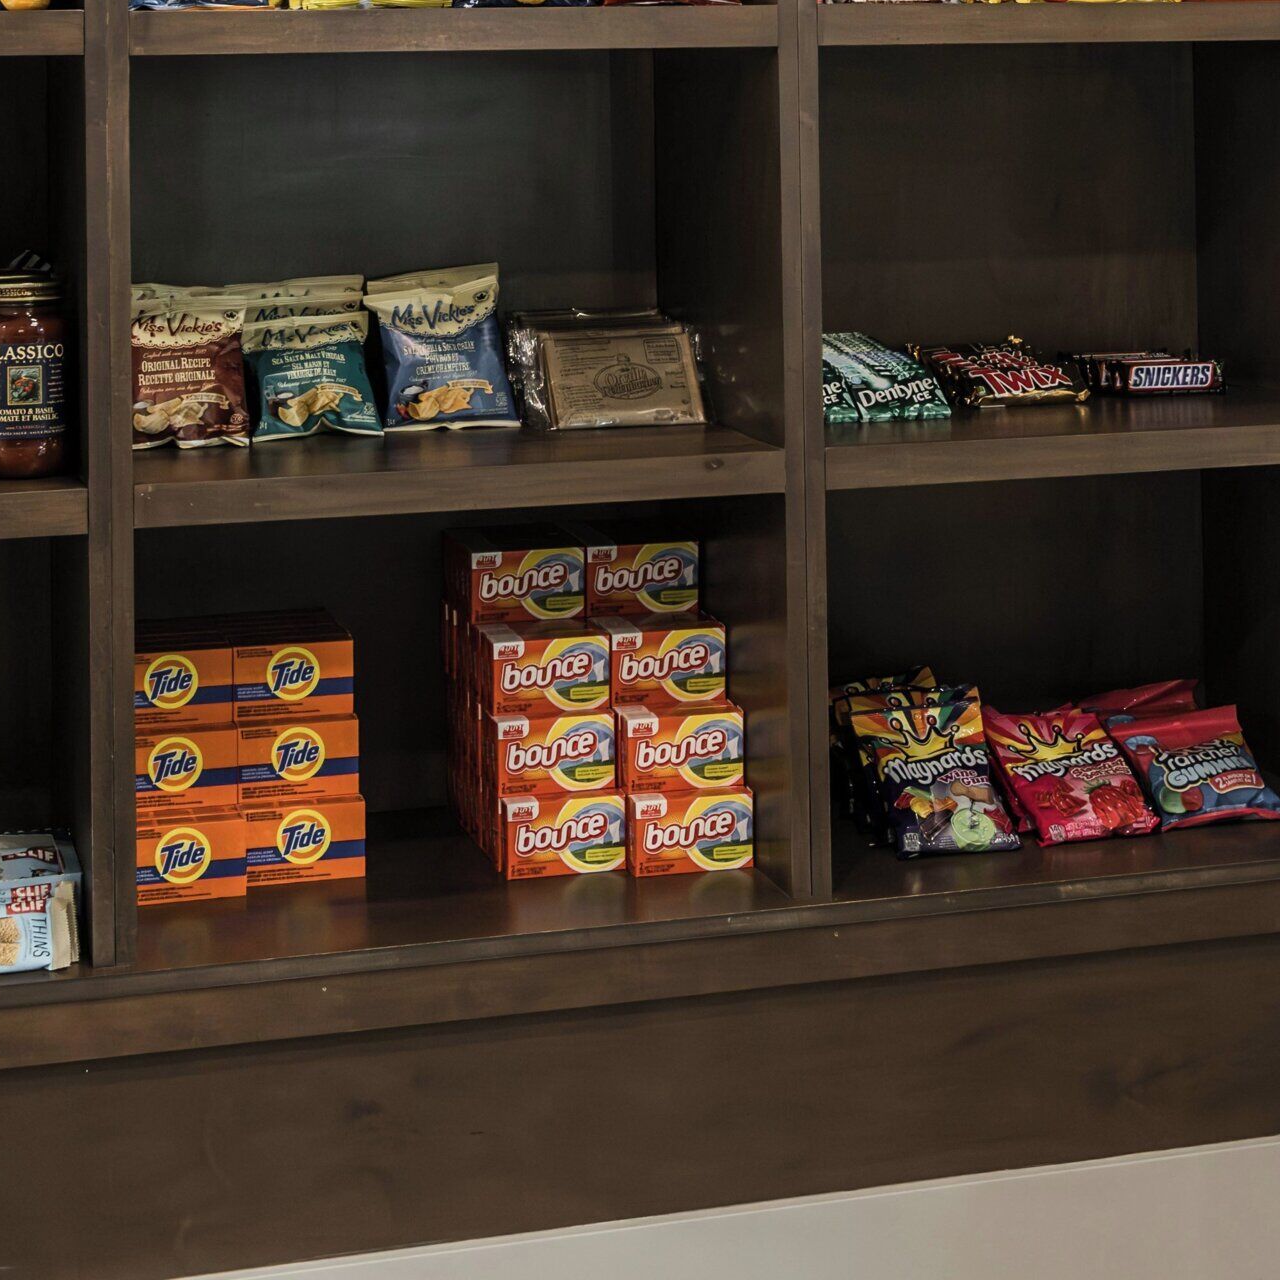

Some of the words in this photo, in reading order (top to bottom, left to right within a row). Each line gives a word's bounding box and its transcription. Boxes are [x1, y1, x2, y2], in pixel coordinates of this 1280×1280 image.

[167, 314, 222, 336] Vickie's
[392, 304, 423, 329] Miss
[422, 300, 475, 329] Vickie's
[138, 373, 173, 386] RECETTE
[175, 370, 215, 382] ORIGINALE
[141, 360, 180, 372] ORIGINAL
[181, 358, 211, 368] RECIPE
[971, 366, 1072, 397] TWIX
[1132, 365, 1210, 388] SNICKERS
[858, 377, 934, 407] Dentyne
[913, 391, 932, 403] ICE
[481, 564, 567, 600] bounce
[596, 558, 680, 592] bounce
[272, 660, 315, 693] Tide
[502, 652, 590, 690] bounce
[621, 645, 708, 681] bounce
[149, 668, 193, 702] Tide
[276, 740, 319, 774] Tide
[509, 733, 596, 771] bounce
[638, 730, 724, 769] bounce
[884, 747, 988, 784] Maynards
[1012, 742, 1118, 782] Maynards
[1168, 747, 1239, 770] rancher
[153, 750, 197, 784] Tide
[937, 770, 977, 783] Wine
[1215, 778, 1226, 788] 2
[282, 823, 325, 857] Tide
[518, 814, 607, 853] bounce
[646, 812, 734, 851] bounce
[161, 842, 205, 876] Tide
[11, 900, 44, 912] CLIF
[31, 917, 51, 958] THINS
